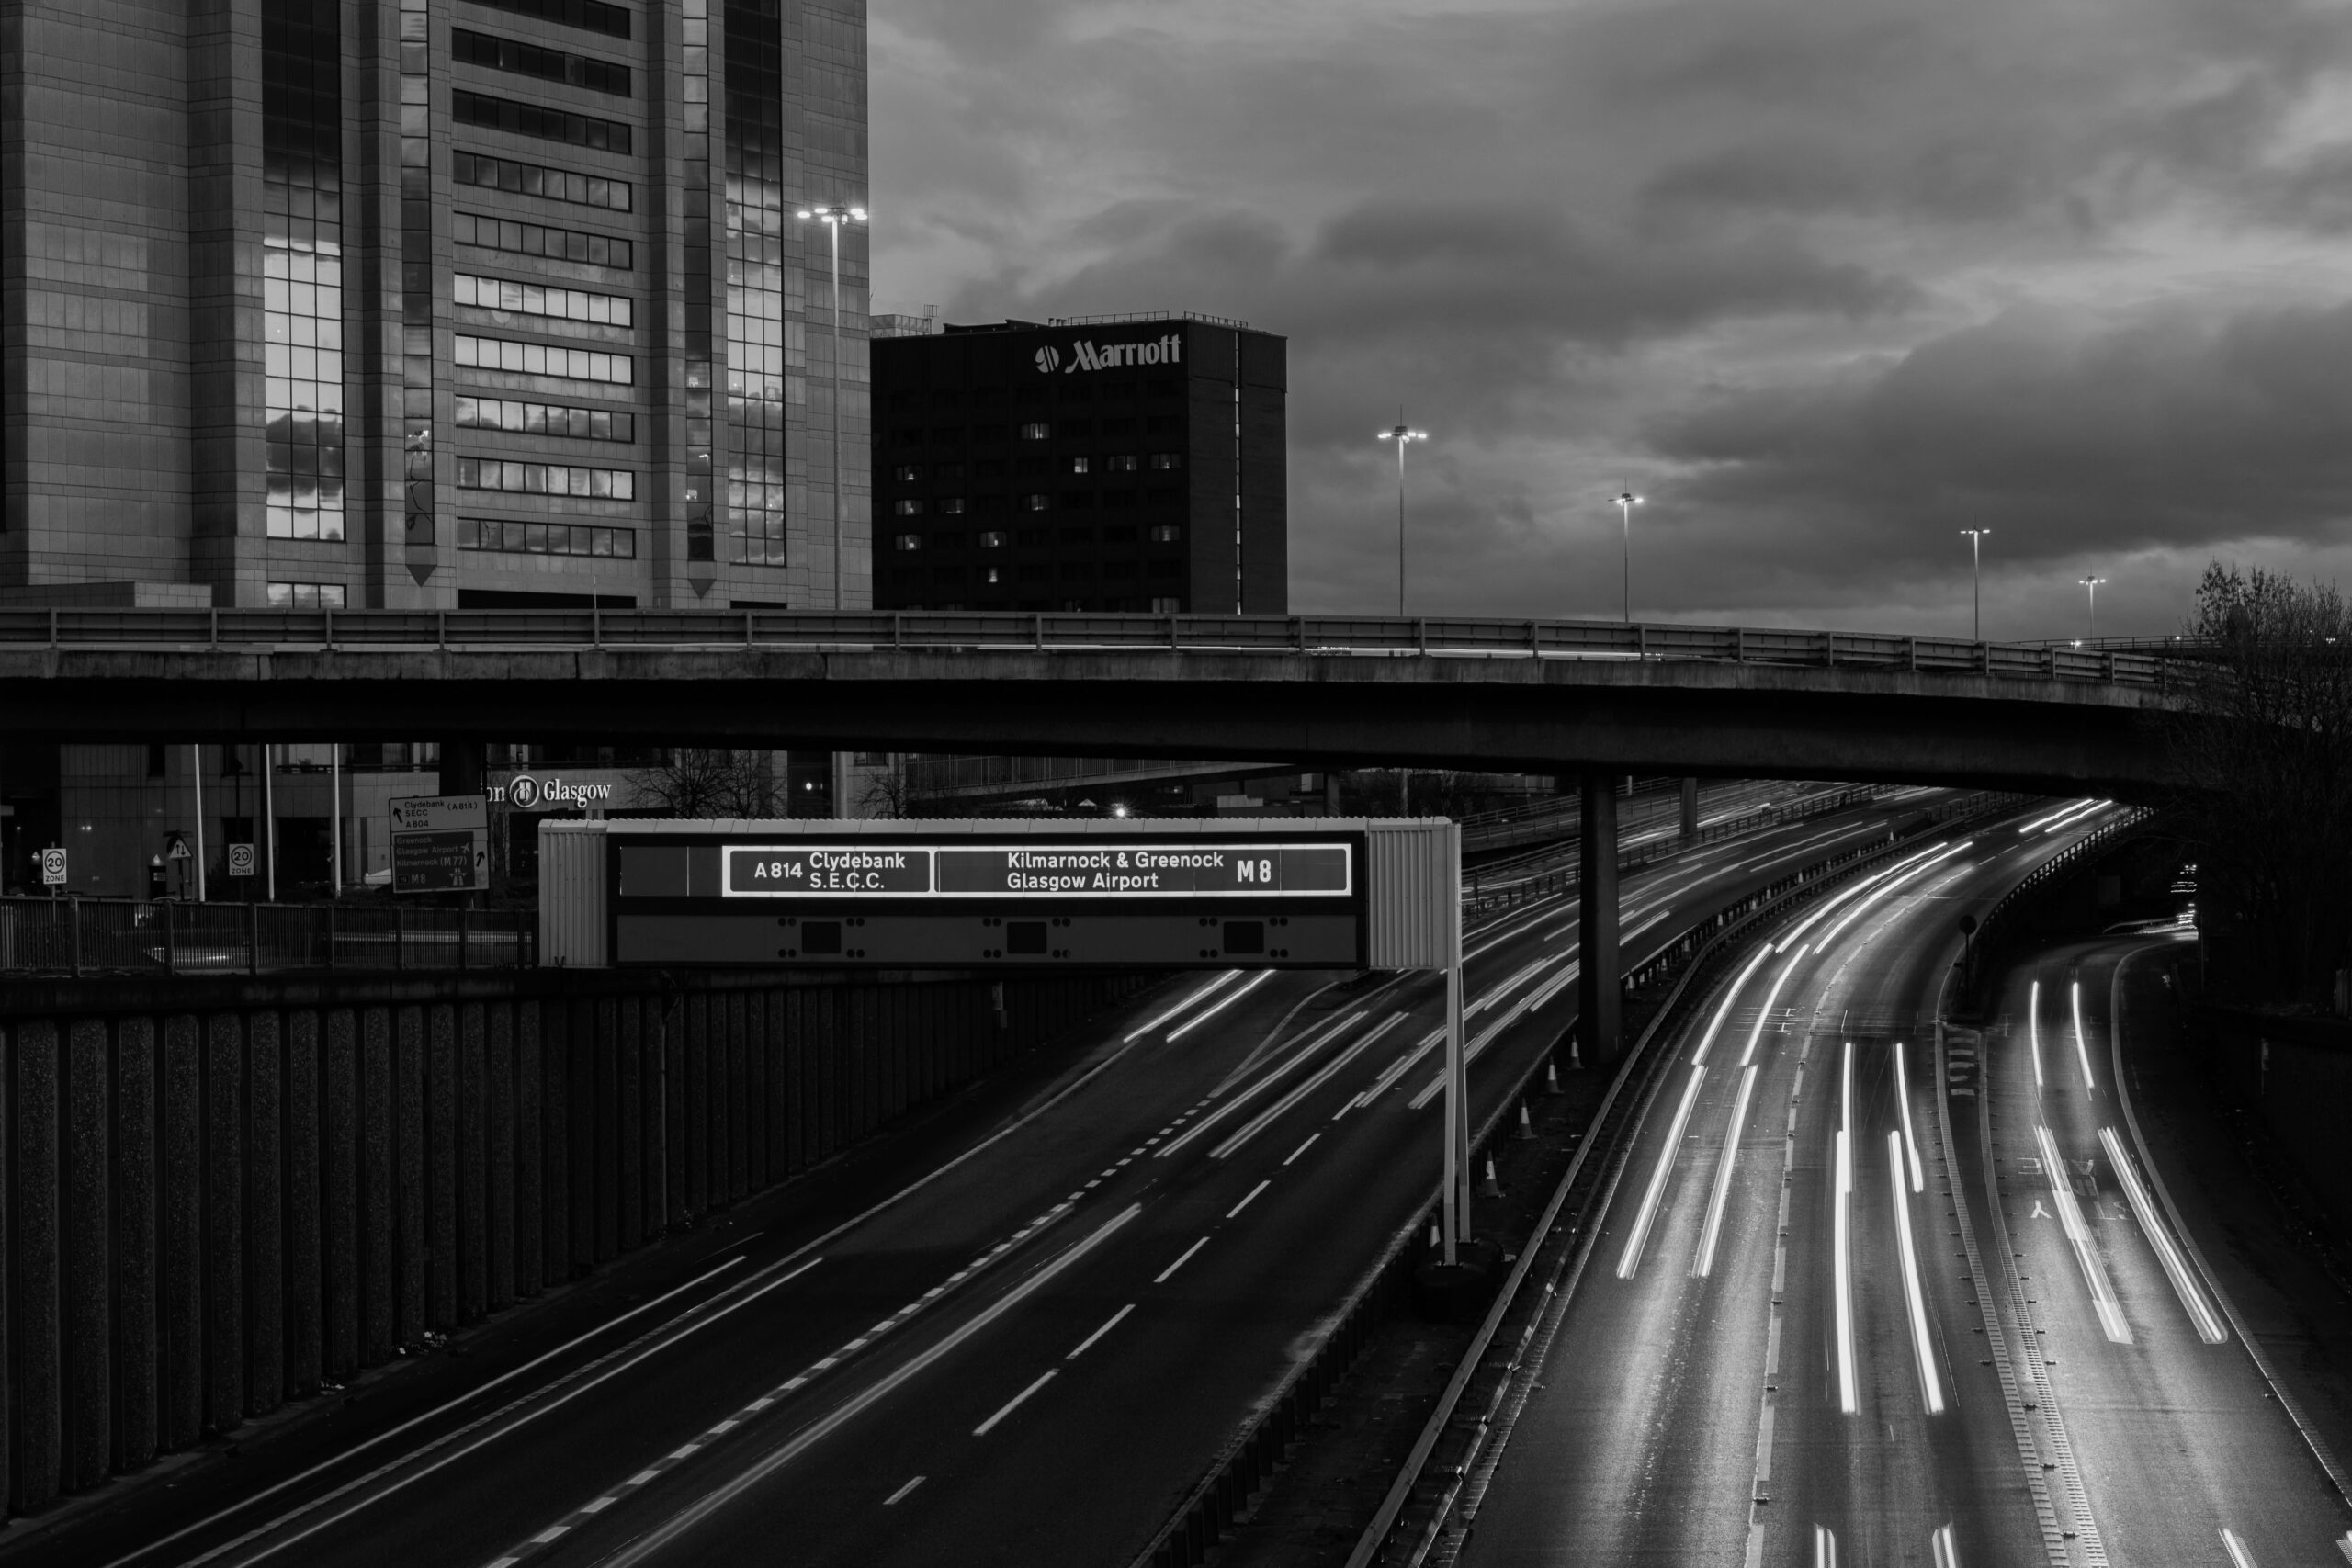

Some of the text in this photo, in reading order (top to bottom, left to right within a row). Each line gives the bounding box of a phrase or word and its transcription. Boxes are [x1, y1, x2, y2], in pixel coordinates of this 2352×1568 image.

[1064, 333, 1182, 374] Marriott
[543, 779, 612, 808] Glasgow
[404, 800, 445, 809] Clydebank
[233, 851, 249, 862] 20
[396, 848, 429, 856] Glasgow
[1008, 851, 1224, 869] Kilmarnock & Greenock
[48, 858, 62, 868] 20
[397, 859, 439, 867] Kilmarnock
[809, 852, 906, 870] Clydebank
[809, 873, 886, 889] S.E.C.C.
[1007, 872, 1159, 892] Glasgow Airport
